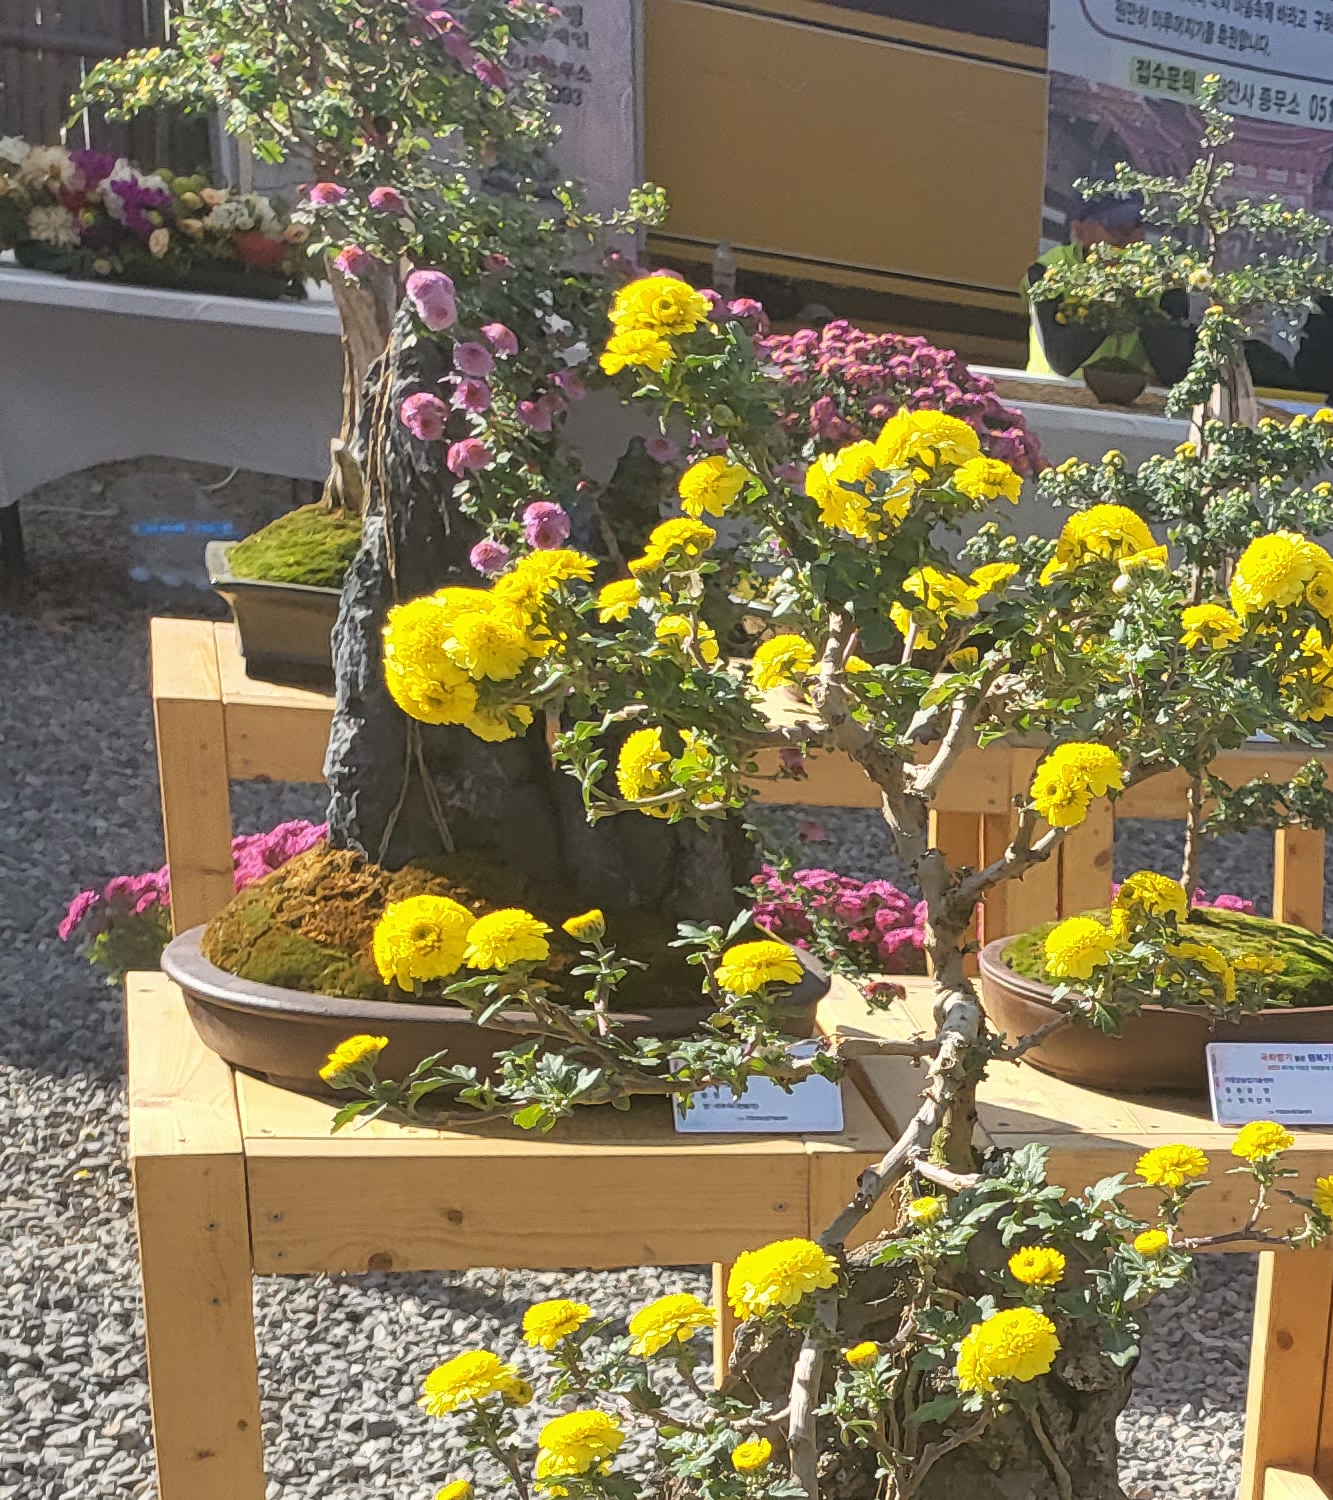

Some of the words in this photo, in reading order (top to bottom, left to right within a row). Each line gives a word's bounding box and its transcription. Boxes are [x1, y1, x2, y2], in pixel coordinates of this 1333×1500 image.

[1135, 58, 1197, 95] 접수문의
[1215, 78, 1255, 109] 안사
[1258, 86, 1301, 115] 종무소
